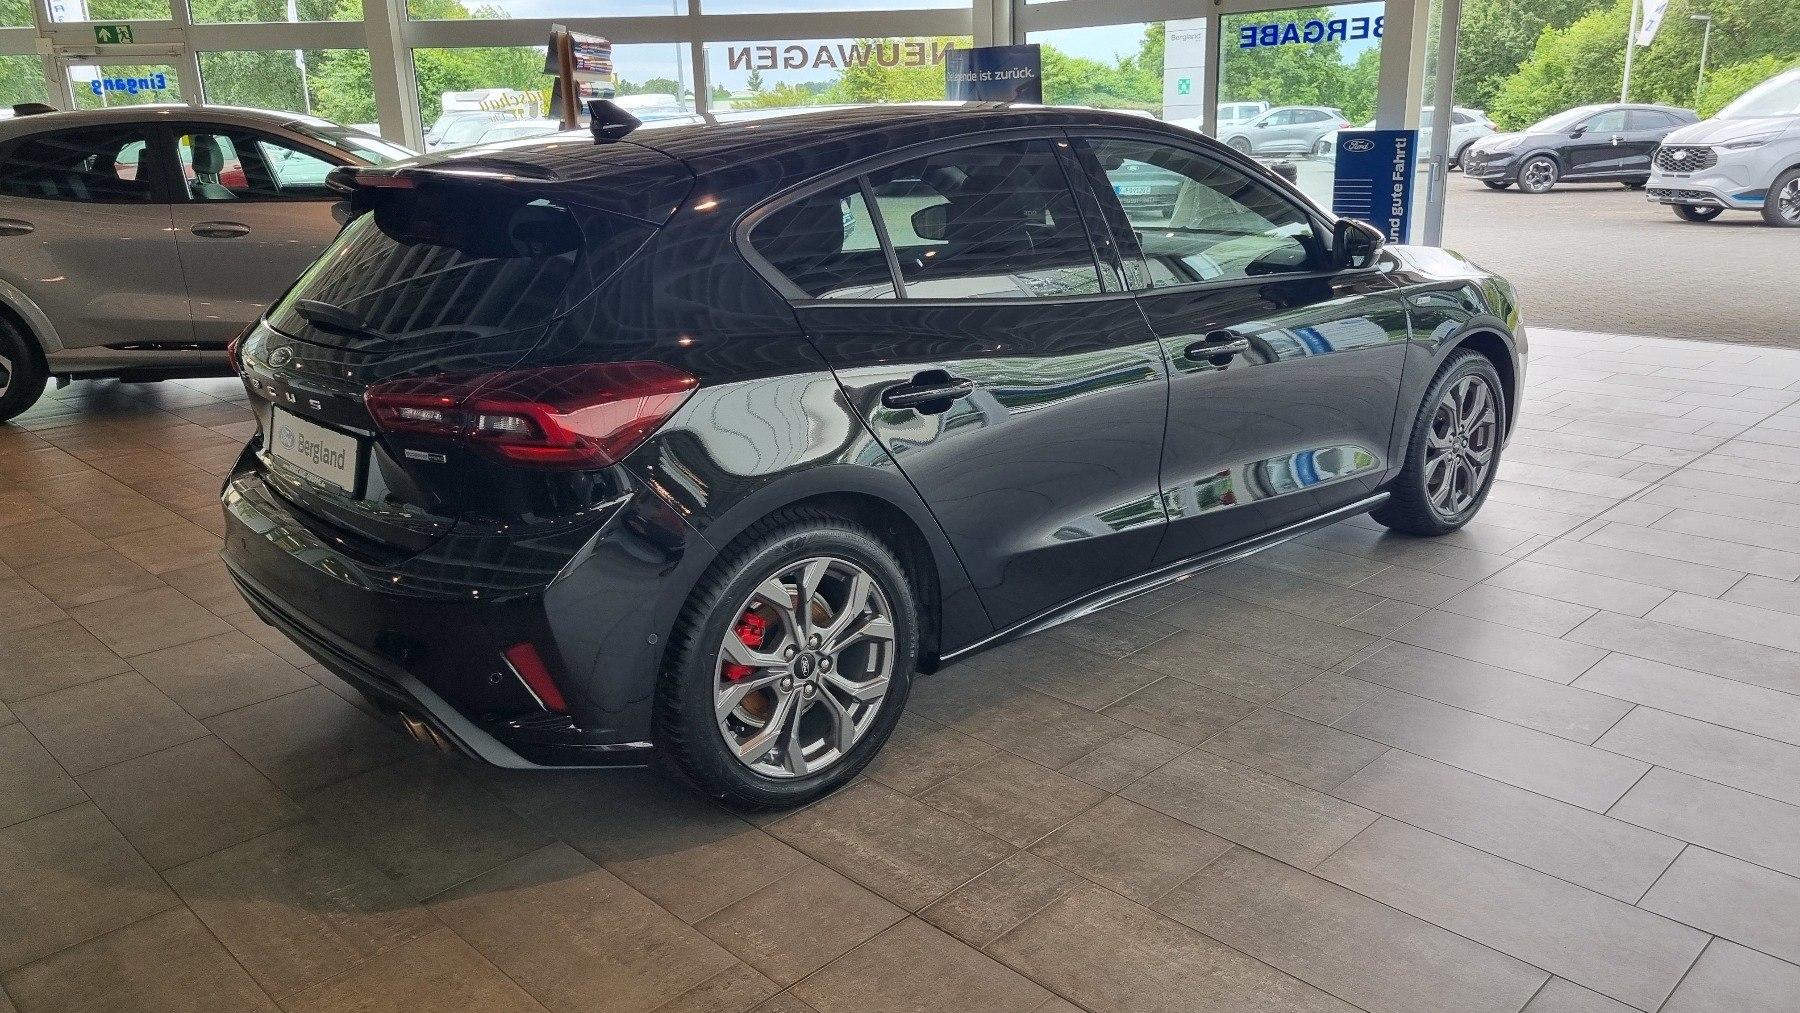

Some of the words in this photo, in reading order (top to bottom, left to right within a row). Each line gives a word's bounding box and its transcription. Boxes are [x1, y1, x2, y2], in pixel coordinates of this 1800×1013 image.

[980, 70, 992, 81] ist
[995, 66, 1035, 80] zurück.
[1392, 138, 1407, 181] Fahrt!
[1391, 183, 1404, 216] gute
[1388, 218, 1400, 245] und
[298, 432, 346, 470] Bergland
